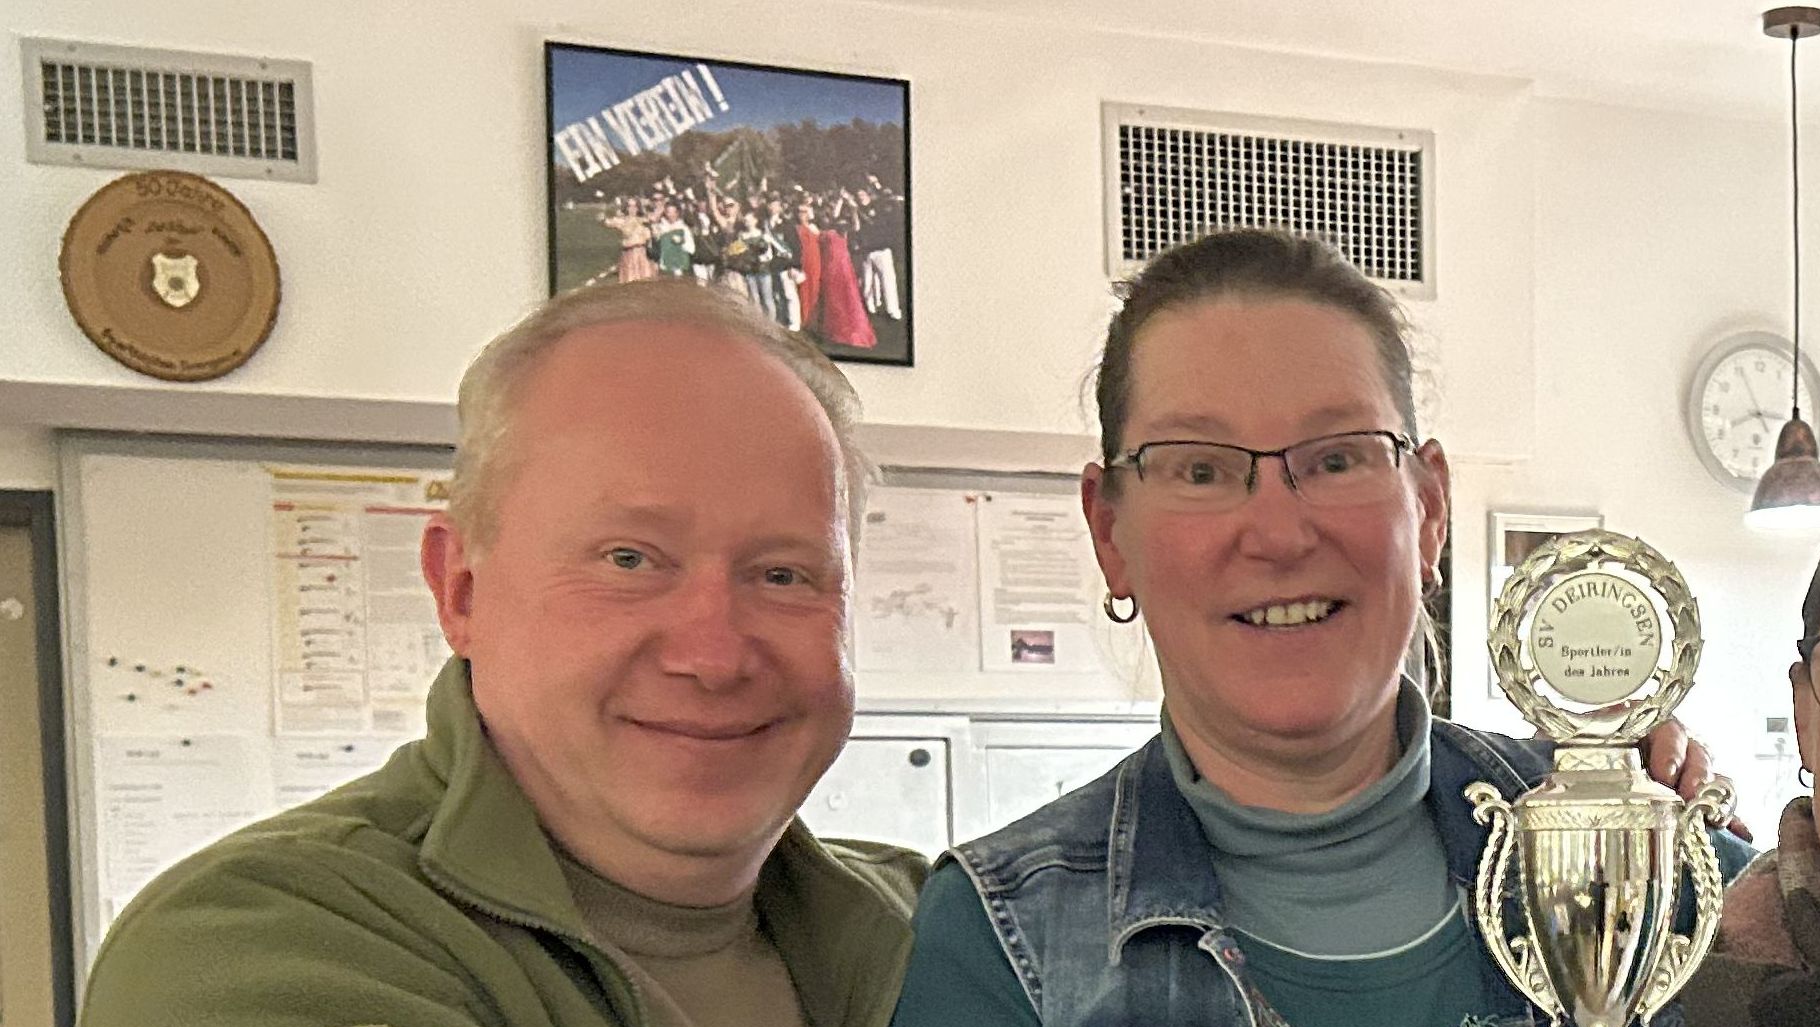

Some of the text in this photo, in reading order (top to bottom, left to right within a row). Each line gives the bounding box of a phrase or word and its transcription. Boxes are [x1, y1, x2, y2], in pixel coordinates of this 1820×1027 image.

[1538, 581, 1655, 649] SV DEIRINGSEN
[1561, 645, 1632, 661] Sportler/in
[1564, 665, 1631, 678] des Jahres
